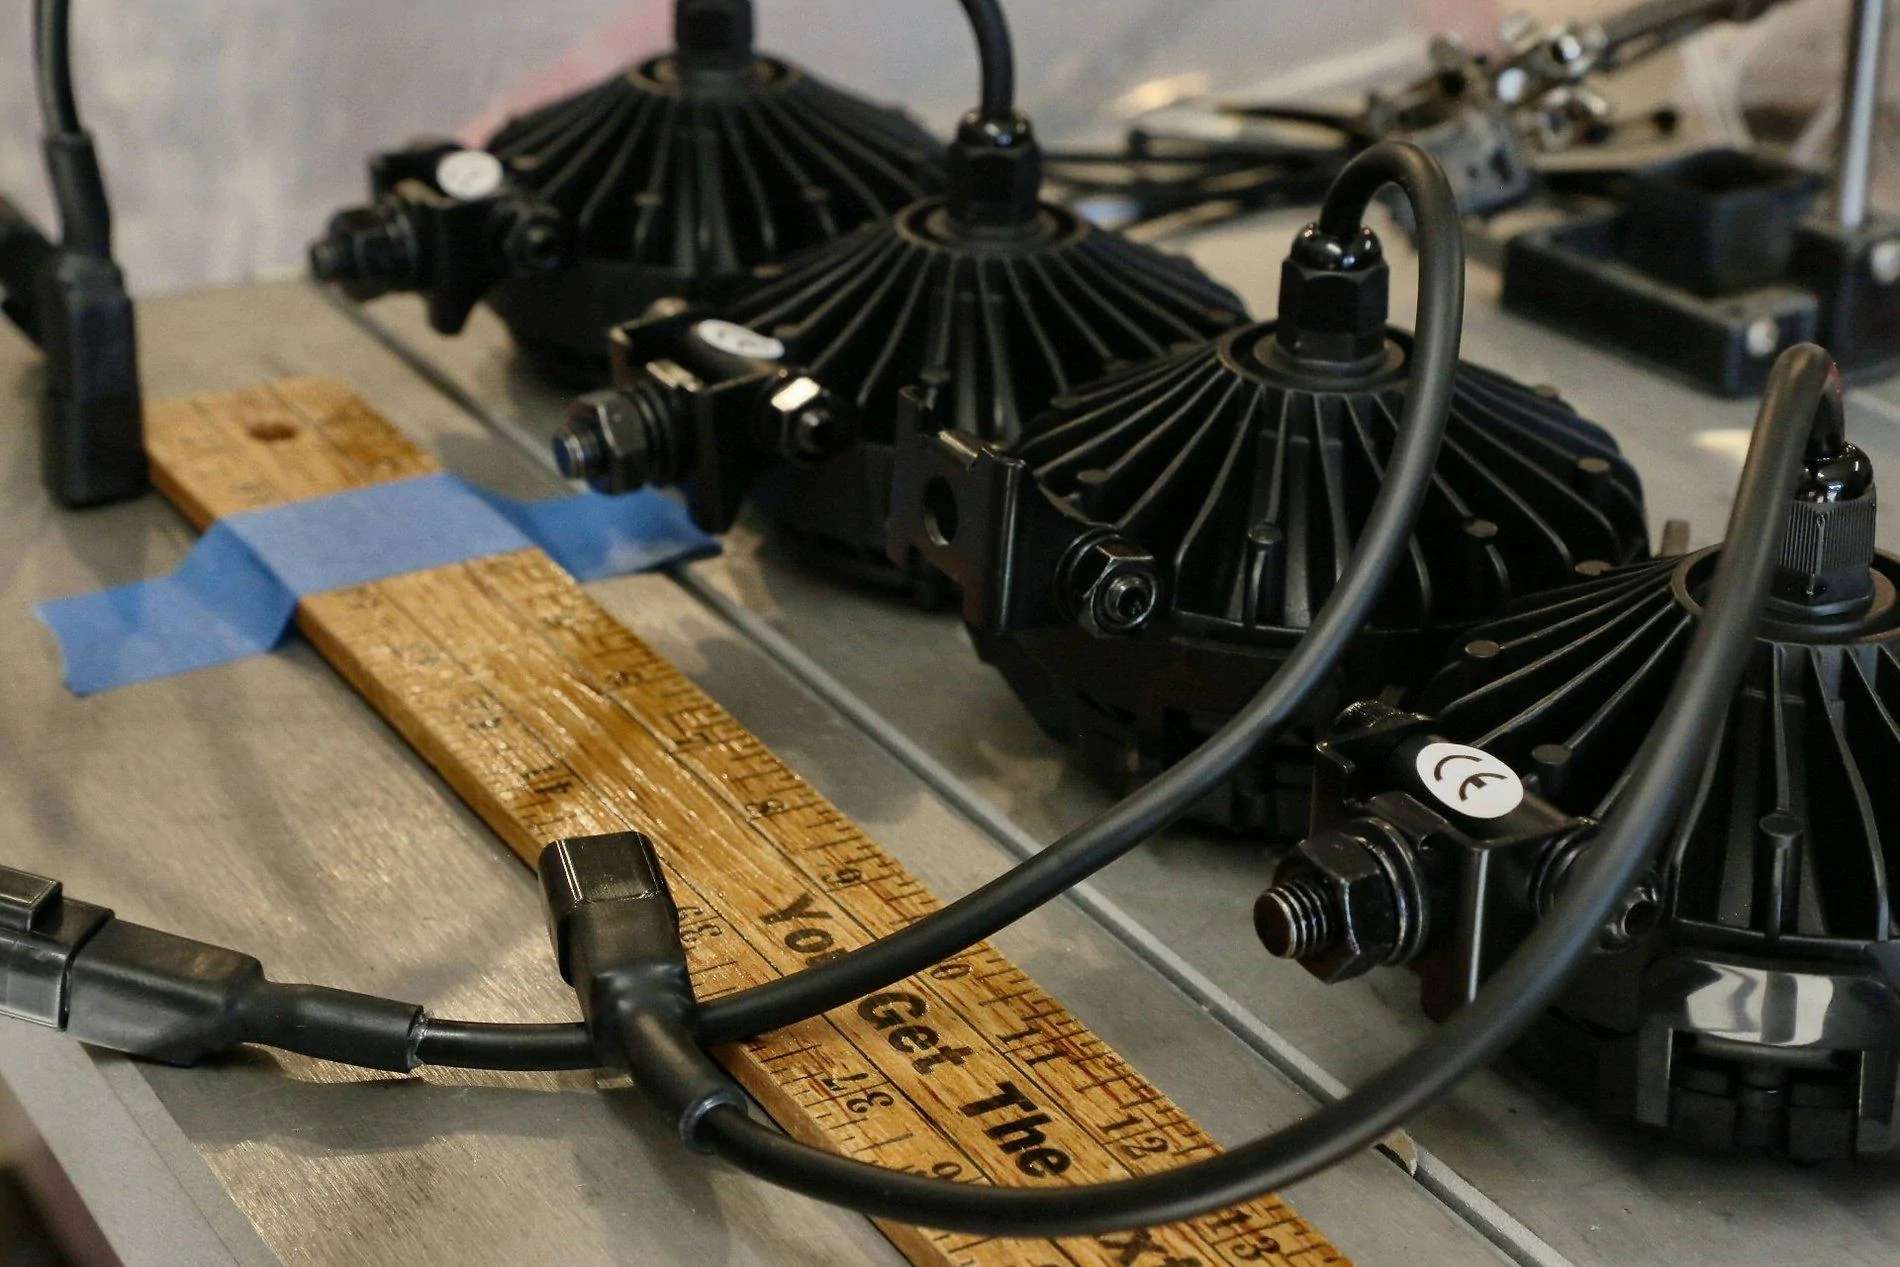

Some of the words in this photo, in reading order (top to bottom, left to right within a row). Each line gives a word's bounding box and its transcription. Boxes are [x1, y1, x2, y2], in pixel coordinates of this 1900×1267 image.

[1433, 754, 1508, 802] CE
[822, 867, 862, 886] 9
[930, 962, 975, 981] 0
[995, 1026, 1069, 1067] 11
[821, 1072, 895, 1114] 37
[857, 991, 974, 1076] Get
[958, 1079, 1072, 1179] The
[1094, 1112, 1169, 1160] 12
[1205, 1208, 1281, 1261] 13
